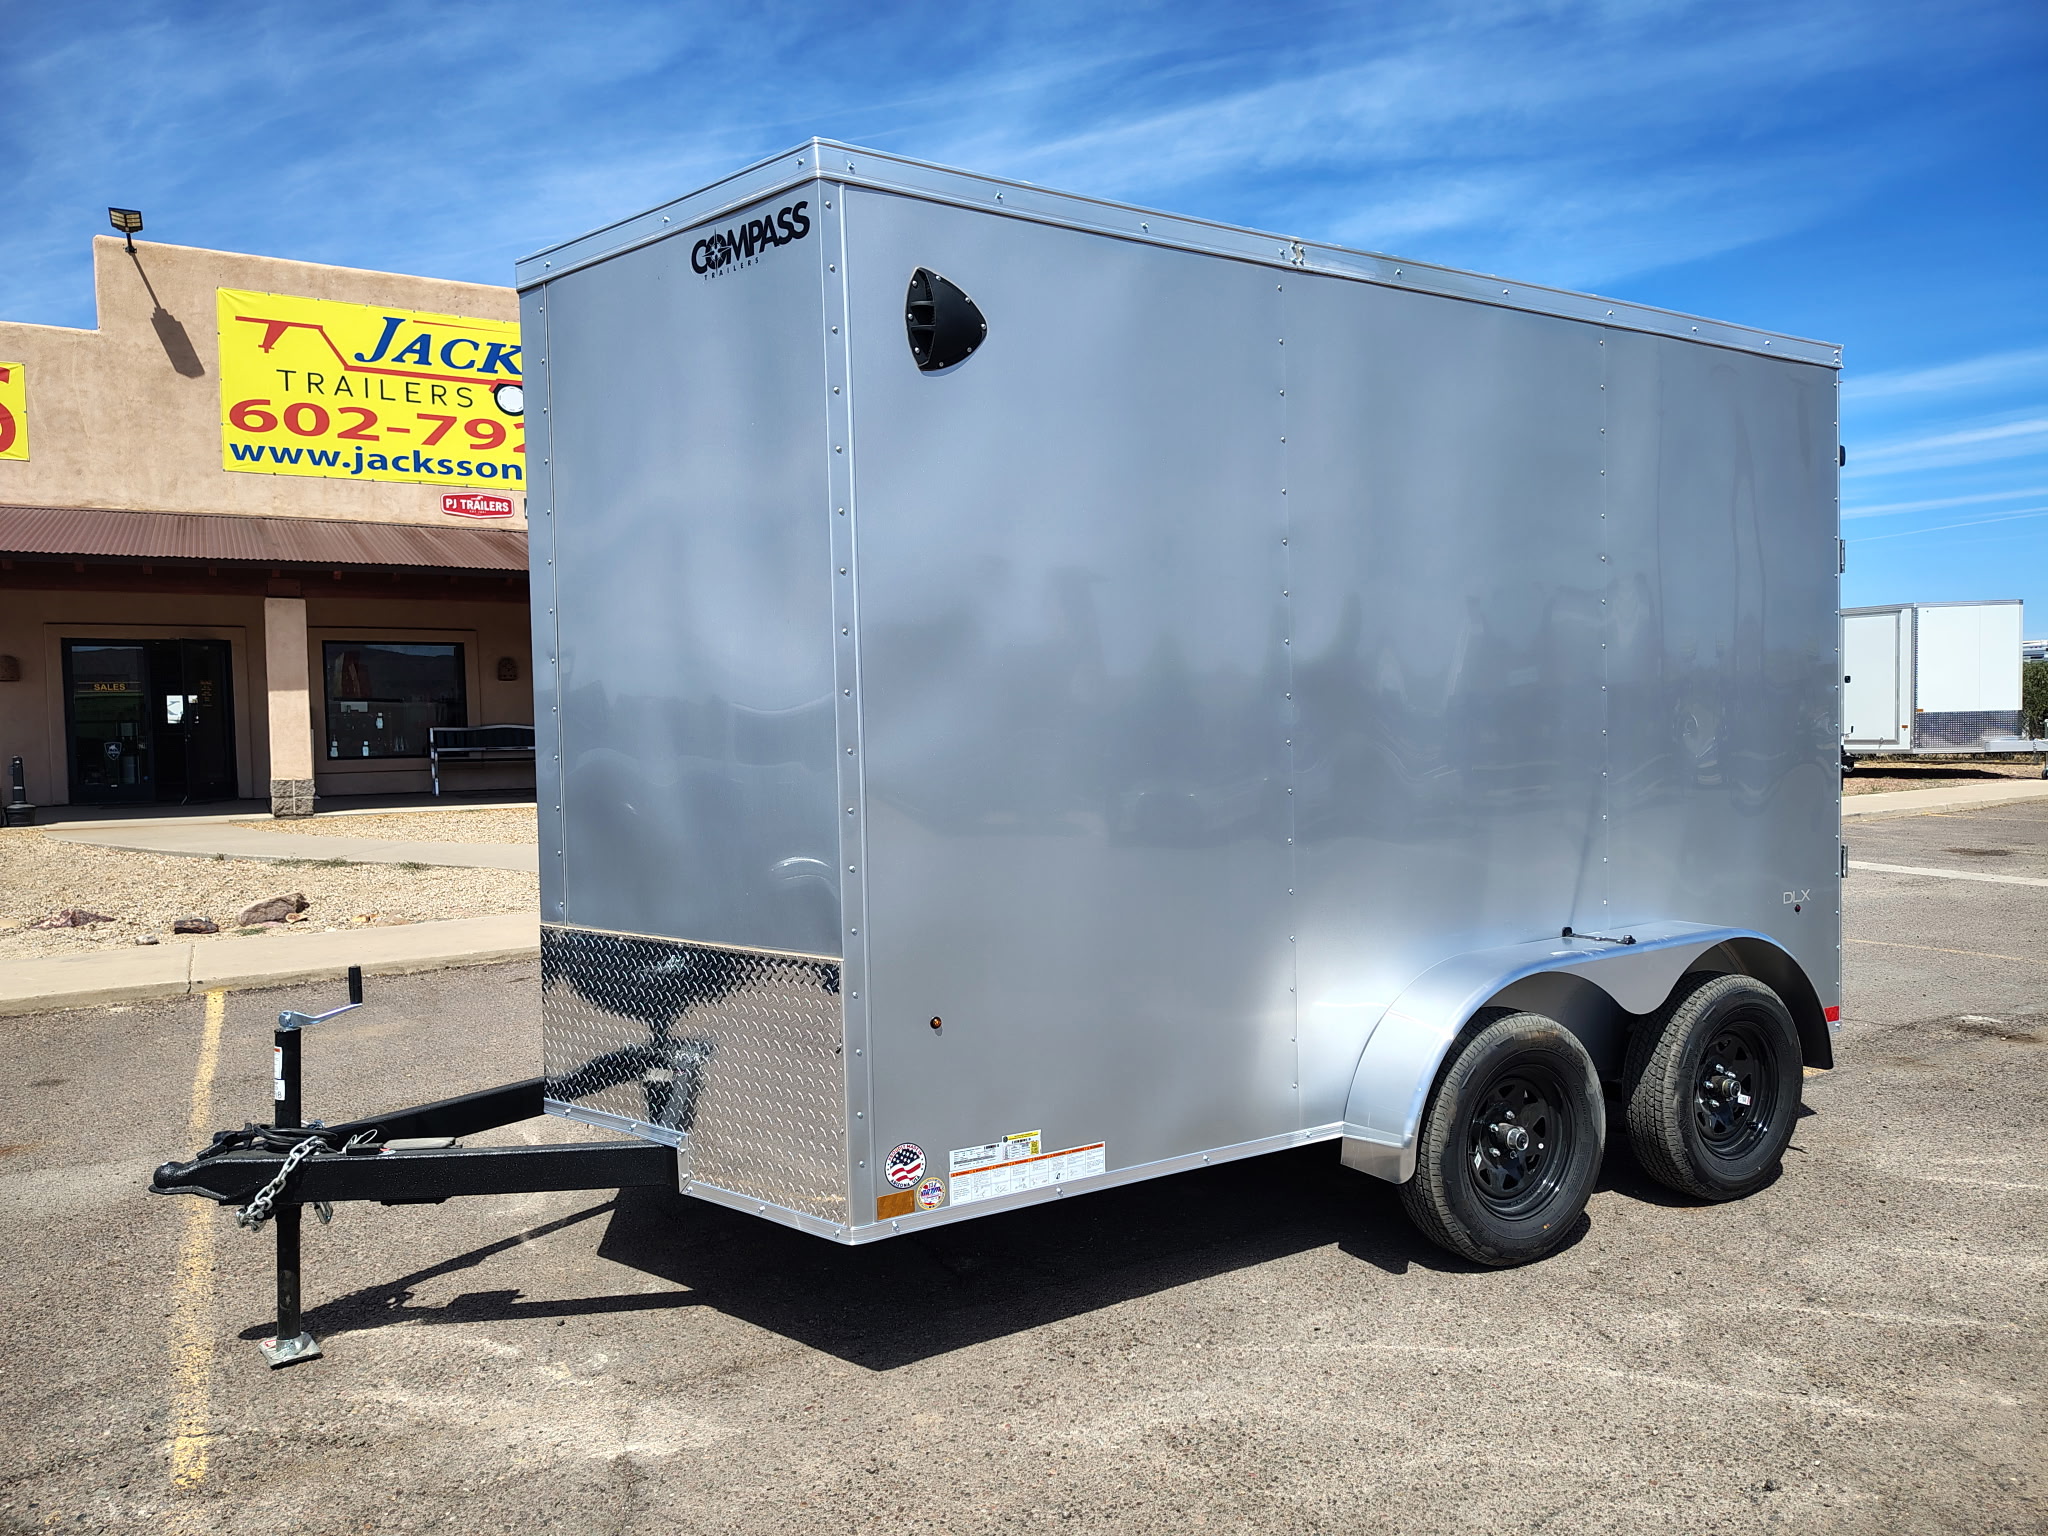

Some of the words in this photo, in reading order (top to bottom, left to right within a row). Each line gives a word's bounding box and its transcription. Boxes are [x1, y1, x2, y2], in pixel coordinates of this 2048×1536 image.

[691, 201, 810, 274] COMPASS
[704, 257, 759, 281] TRAILERS
[276, 369, 474, 408] TRAILERS
[229, 399, 525, 453] 602-79
[229, 442, 522, 480] www.jacksson
[445, 498, 457, 509] PJ
[460, 499, 509, 512] TRAILERS
[93, 683, 126, 691] SALES
[1783, 889, 1810, 904] DLX
